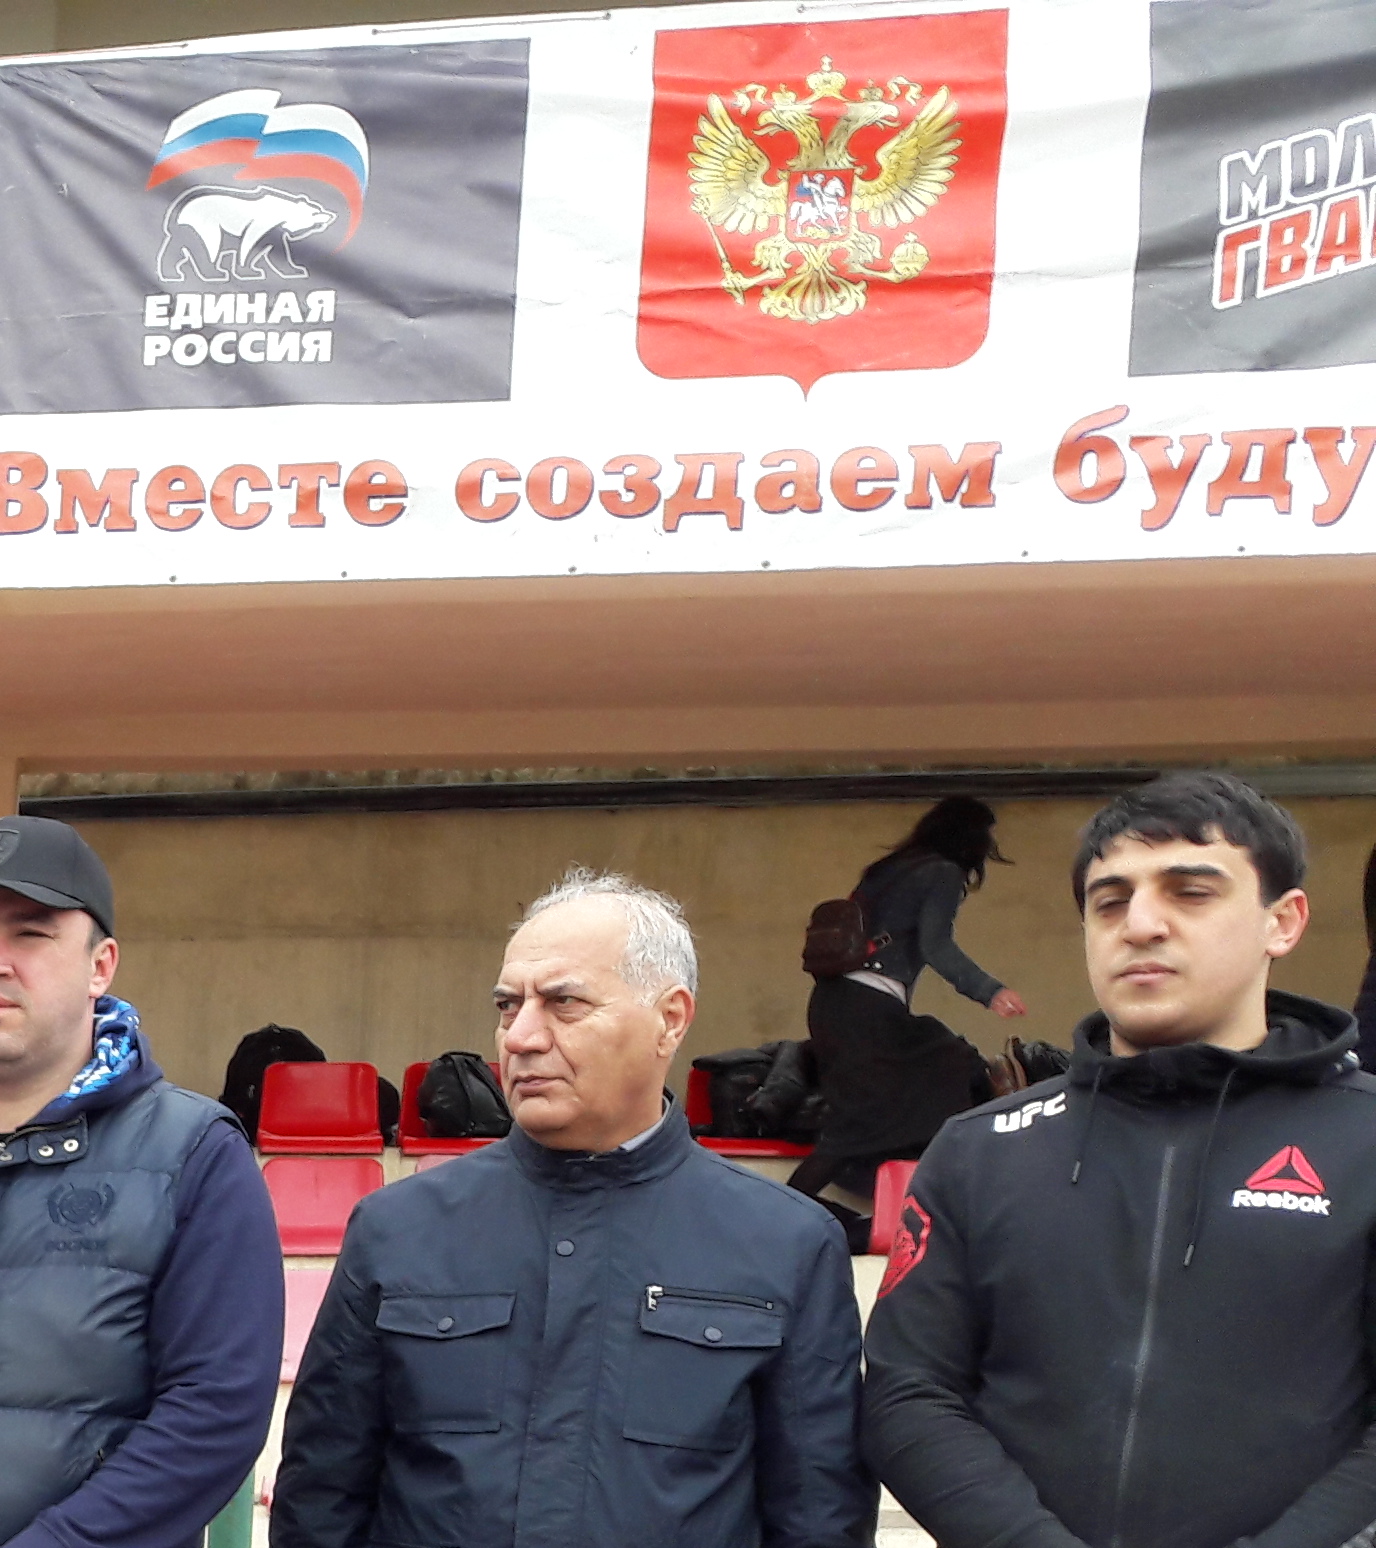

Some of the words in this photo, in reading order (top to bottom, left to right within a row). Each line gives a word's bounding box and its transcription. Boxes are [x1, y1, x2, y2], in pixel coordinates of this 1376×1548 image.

[1212, 188, 1376, 309] ГВА
[144, 290, 337, 330] ЕДИНАЯ
[143, 330, 333, 366] РОССИЯ
[455, 441, 1002, 532] создаем
[994, 1091, 1067, 1133] UFC
[1231, 1189, 1331, 1215] Reebok
